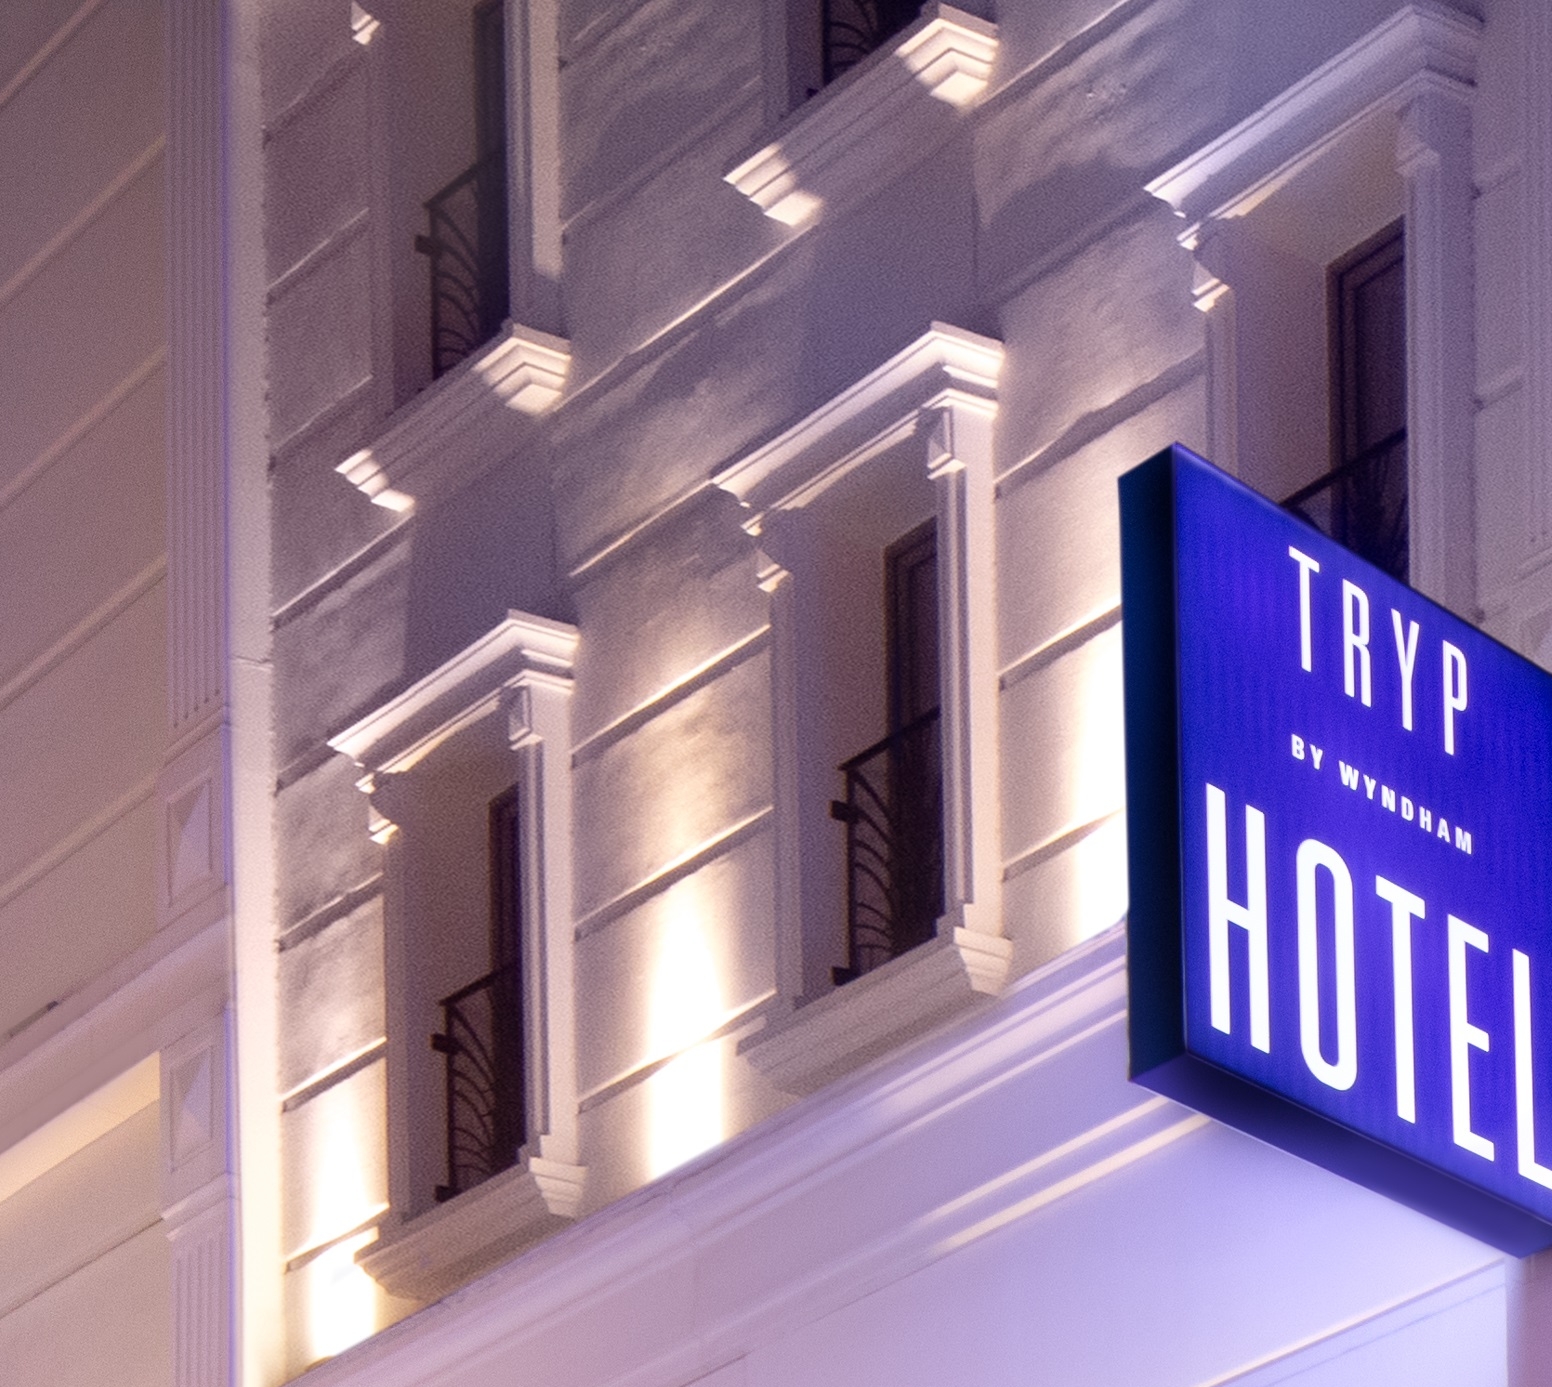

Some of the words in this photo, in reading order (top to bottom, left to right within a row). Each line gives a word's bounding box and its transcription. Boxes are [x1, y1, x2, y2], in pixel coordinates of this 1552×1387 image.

[1288, 545, 1468, 756] TRYP
[1291, 733, 1323, 770] BY
[1338, 760, 1472, 855] WYNDHAM
